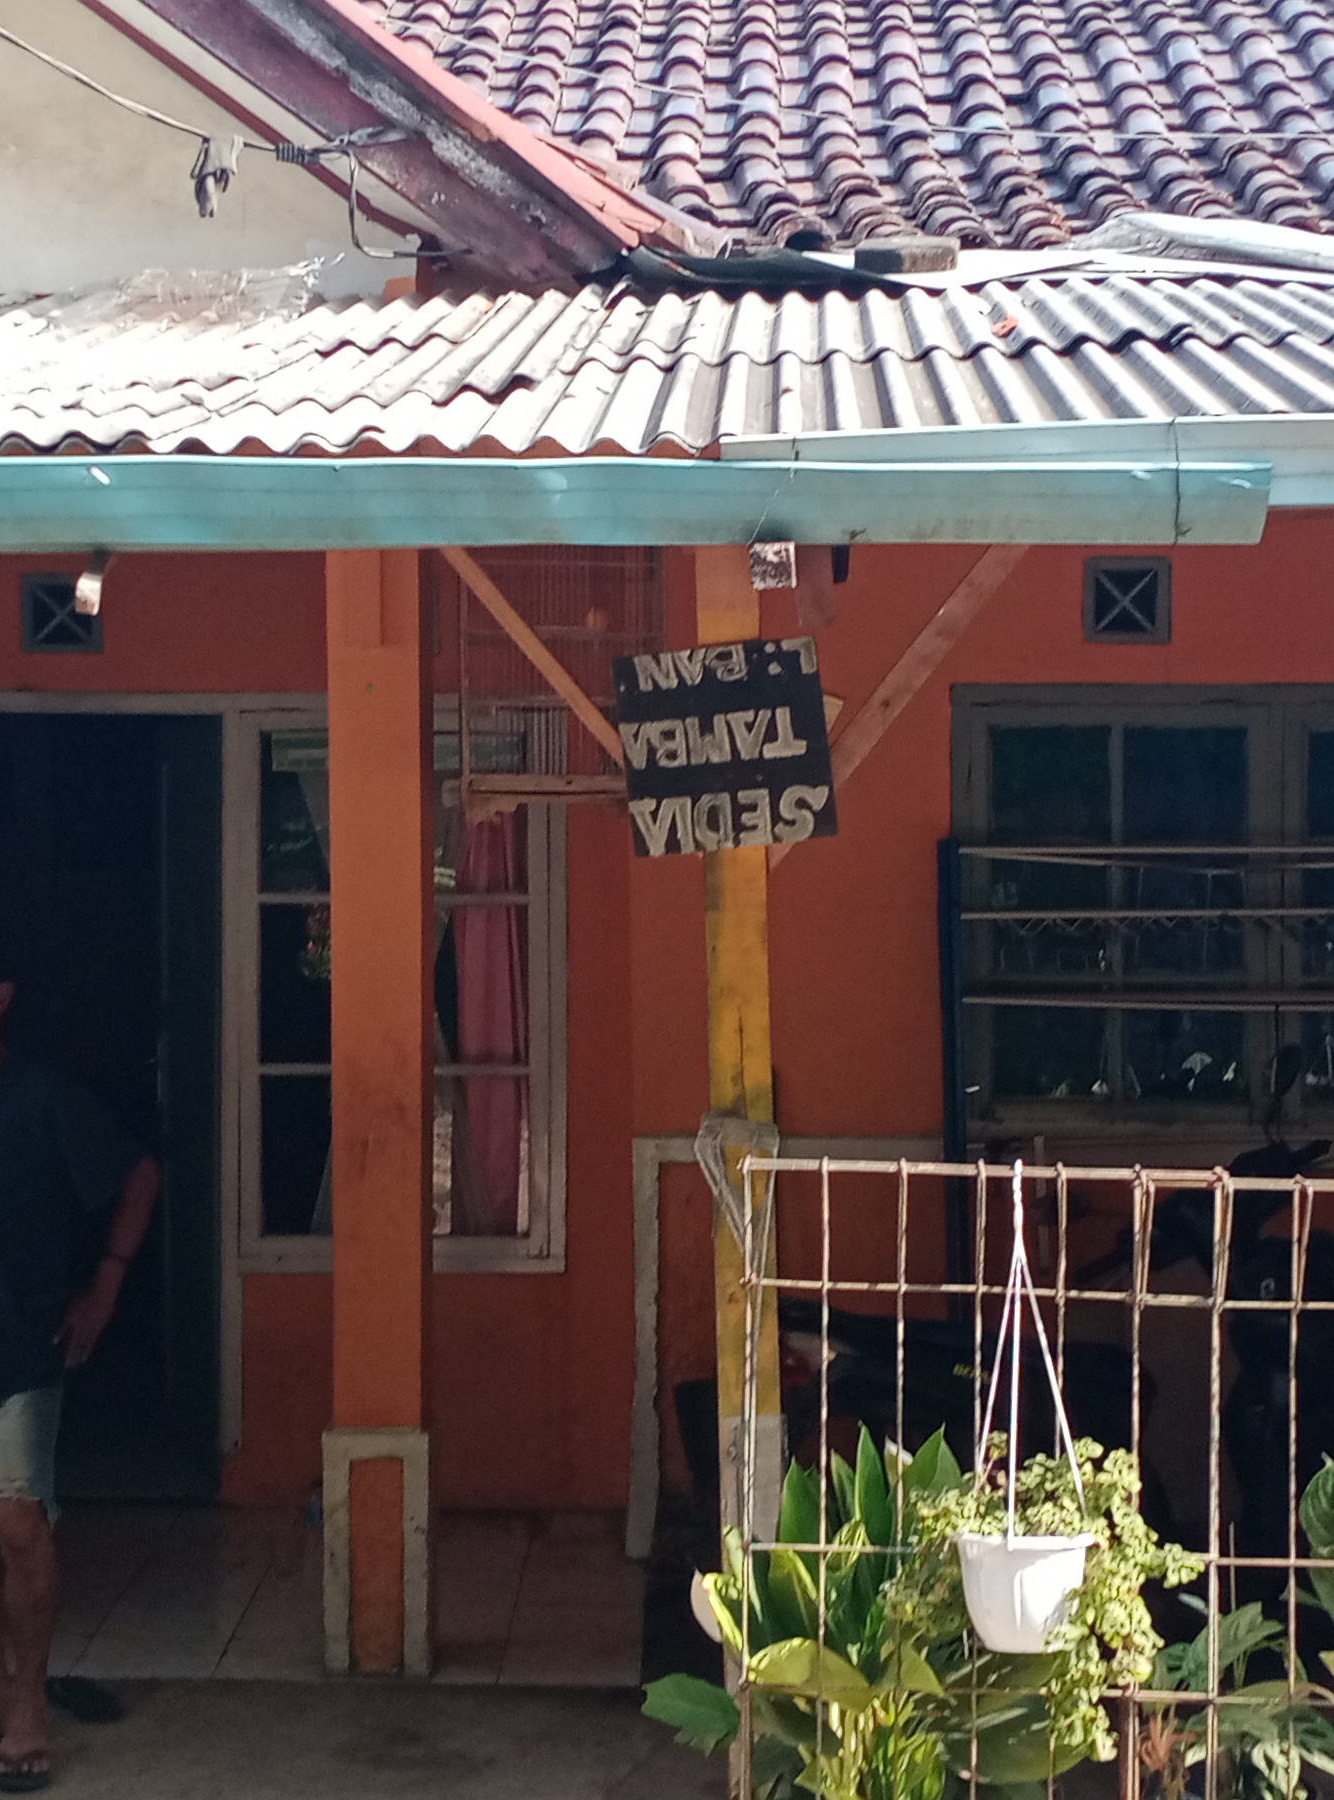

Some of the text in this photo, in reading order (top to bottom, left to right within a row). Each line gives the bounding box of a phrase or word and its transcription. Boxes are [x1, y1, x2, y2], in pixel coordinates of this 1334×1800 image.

[633, 643, 748, 692] BAN
[618, 705, 808, 770] TAMBA
[628, 784, 829, 857] SEDIA
